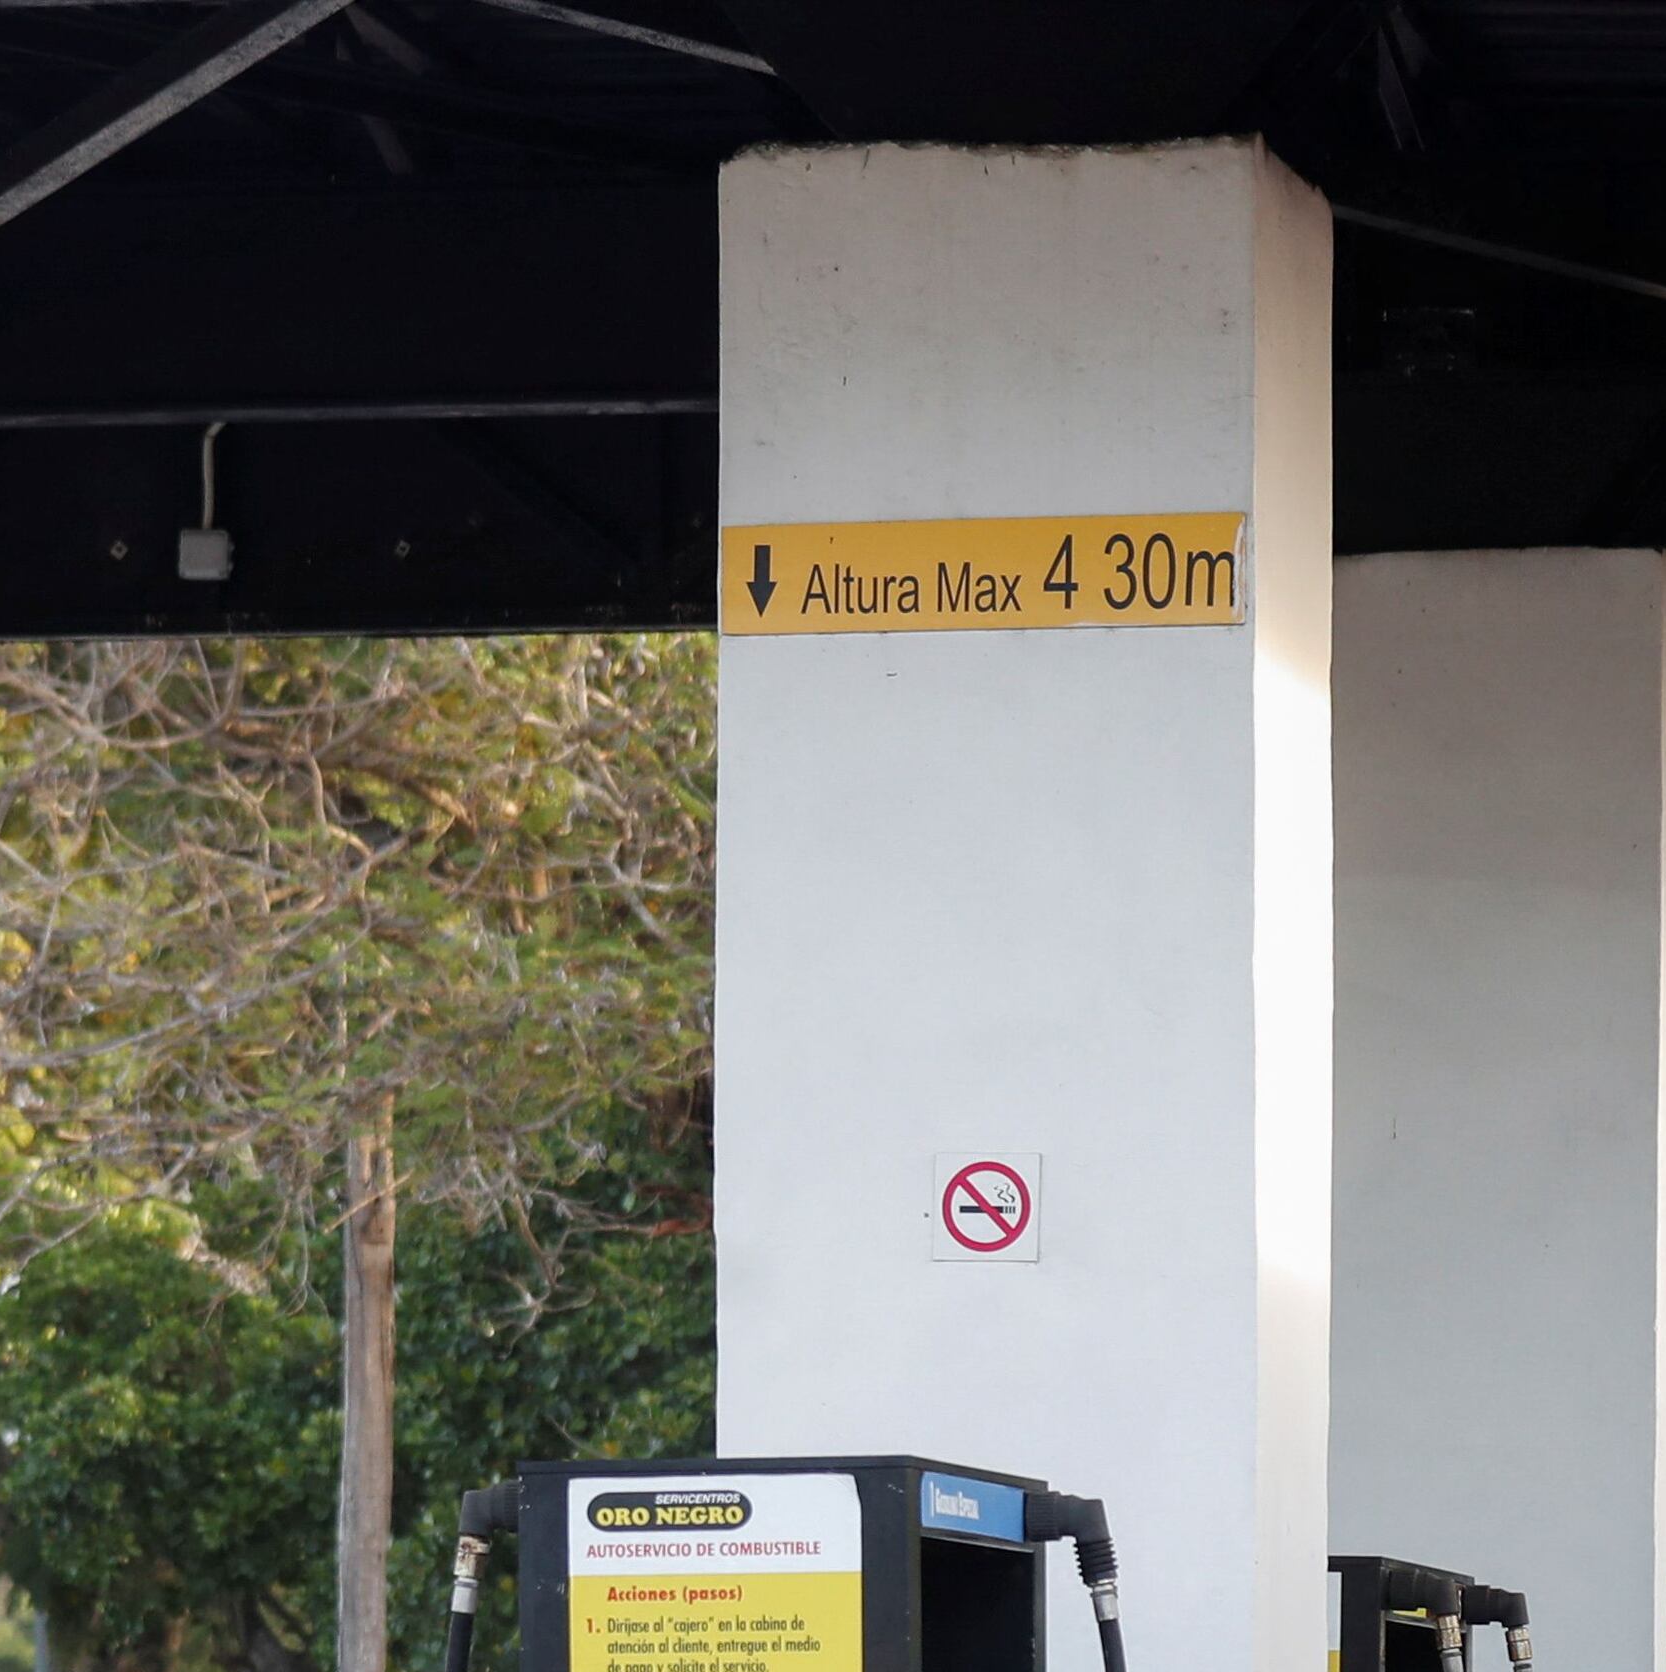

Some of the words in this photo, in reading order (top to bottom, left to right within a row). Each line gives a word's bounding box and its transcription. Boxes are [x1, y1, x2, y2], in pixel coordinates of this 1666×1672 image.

[801, 563, 920, 614] Altura
[936, 561, 1022, 613] Max
[1043, 534, 1079, 610] 4
[1103, 532, 1235, 609] 30m
[655, 1493, 740, 1505] SERVICENTROS
[595, 1506, 650, 1527] ORO
[655, 1505, 744, 1526] NEGRO
[587, 1543, 691, 1559] AUTOSERVICIO
[697, 1542, 715, 1557] DE
[719, 1540, 821, 1556] COMBUSTIBLE
[607, 1585, 676, 1602] Acciones
[683, 1585, 743, 1605] (pasos)
[585, 1617, 601, 1634] 1.
[653, 1616, 664, 1633] al
[718, 1620, 732, 1632] en
[736, 1615, 746, 1631] la
[750, 1615, 787, 1632] cabina
[791, 1613, 805, 1631] de
[607, 1639, 655, 1654] atención
[658, 1636, 669, 1653] al
[672, 1637, 714, 1655] cliente,
[717, 1639, 768, 1656] entregue
[771, 1635, 781, 1651] el
[785, 1635, 821, 1652] medio
[709, 1657, 720, 1672] el
[723, 1658, 769, 1672] servicio.
